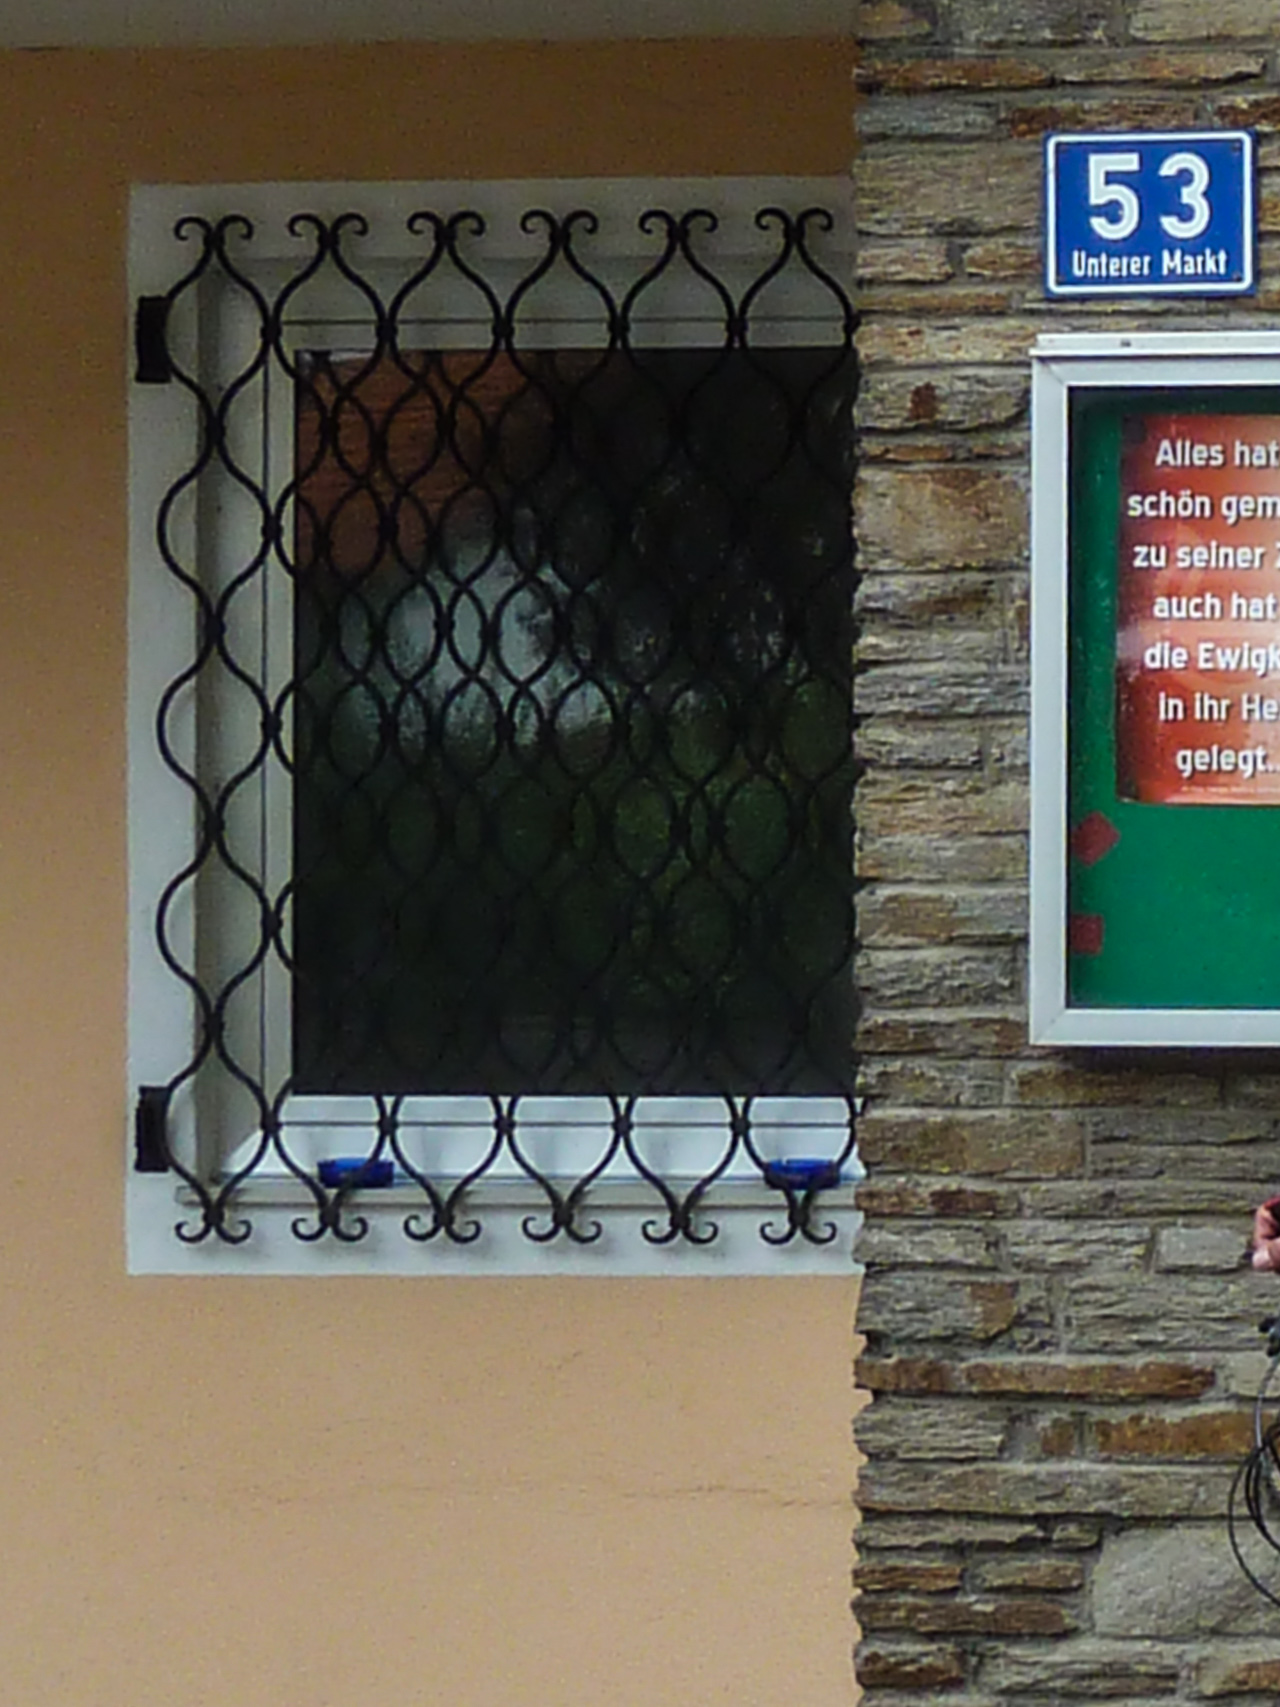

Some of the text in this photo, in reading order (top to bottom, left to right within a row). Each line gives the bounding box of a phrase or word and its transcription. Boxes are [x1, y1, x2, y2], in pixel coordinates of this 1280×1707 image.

[1088, 152, 1210, 240] 53
[1072, 247, 1227, 277] Unterer Markt
[1155, 438, 1224, 466] Alles
[1233, 439, 1280, 466] hat
[1127, 489, 1211, 518] schön
[1132, 545, 1166, 568] zu
[1176, 539, 1265, 568] seiner
[1153, 592, 1221, 619] auch
[1231, 592, 1277, 620] hat
[1144, 641, 1188, 669] die
[1159, 691, 1184, 721] in
[1194, 692, 1231, 721] ihr
